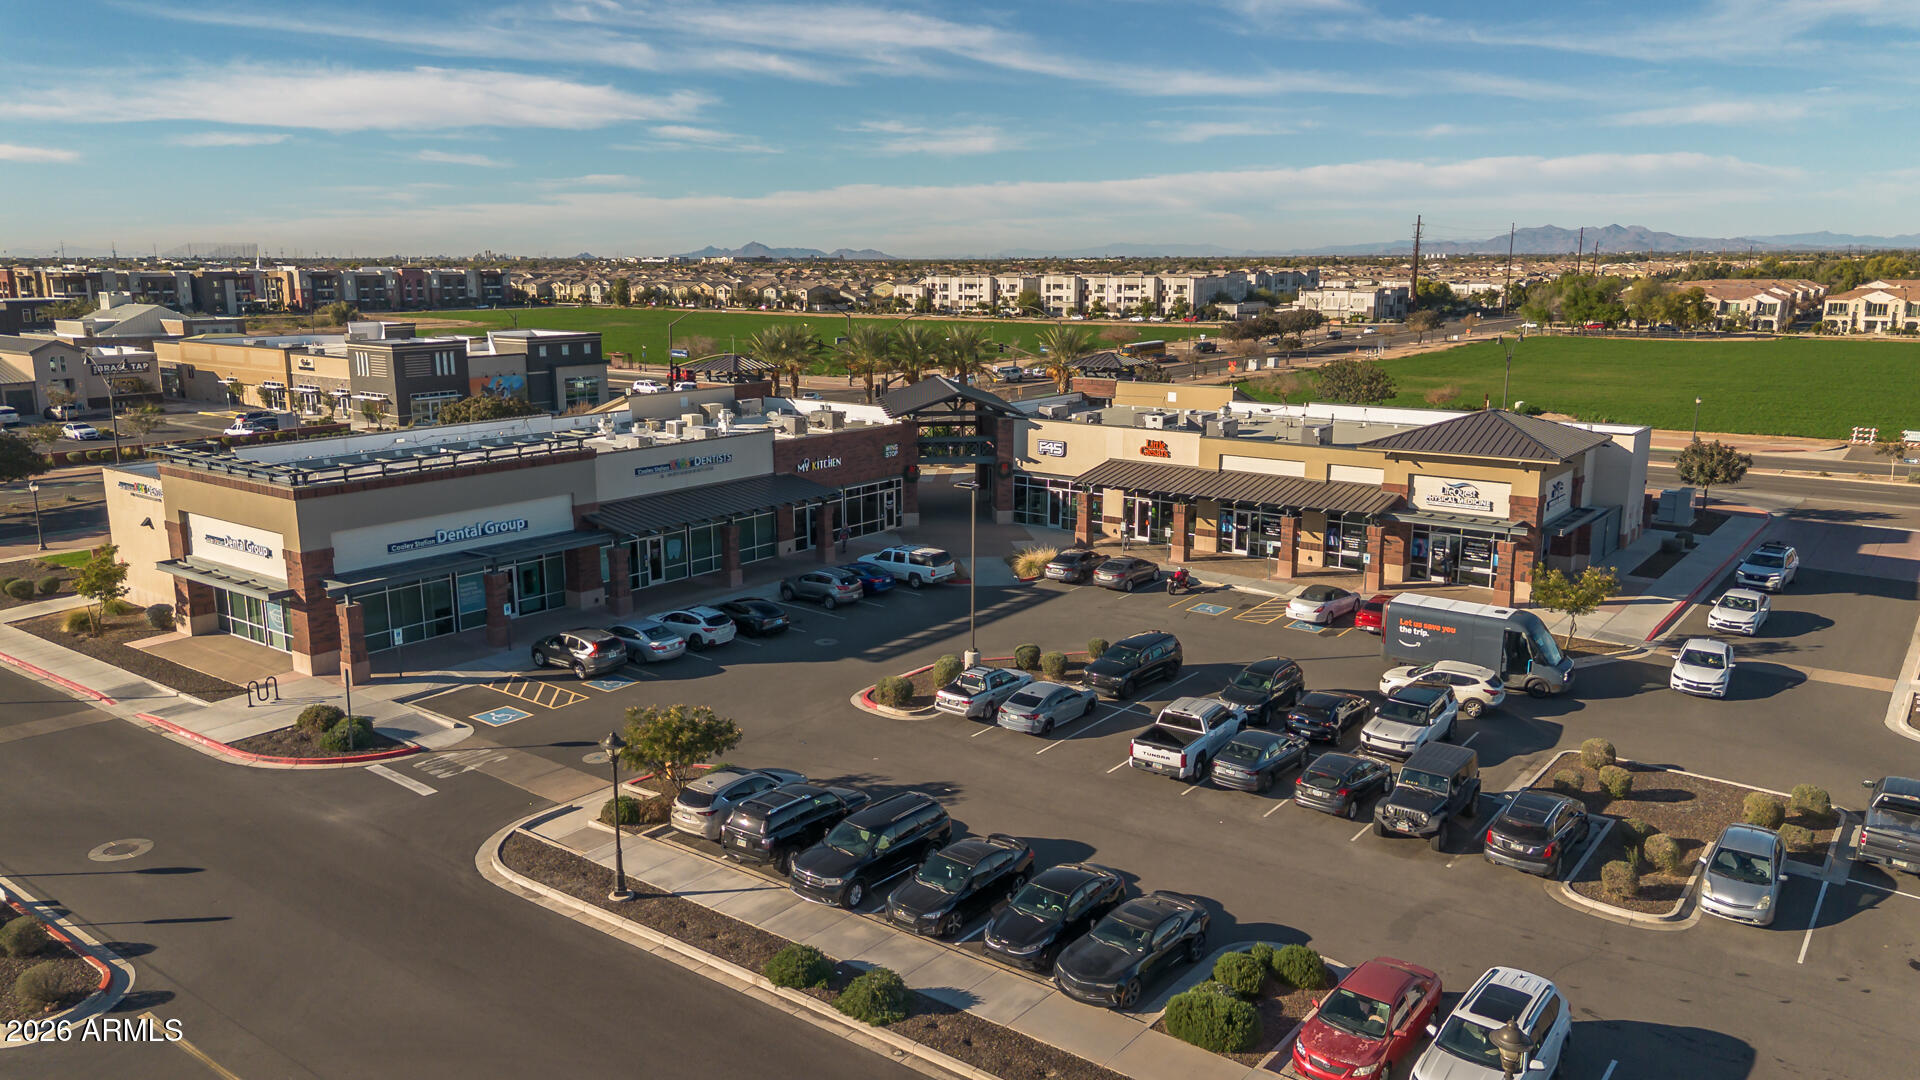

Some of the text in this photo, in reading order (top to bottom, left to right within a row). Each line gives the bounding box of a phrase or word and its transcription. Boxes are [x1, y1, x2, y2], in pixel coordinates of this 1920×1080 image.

[130, 362, 149, 370] TAP
[1039, 441, 1063, 454] F45
[1145, 439, 1167, 450] Little
[694, 454, 732, 467] DENTISTS
[811, 456, 842, 471] KITCHEN
[436, 523, 482, 544] Dental
[484, 519, 526, 535] Group
[224, 535, 247, 552] Dental
[247, 541, 269, 558] Group
[1400, 617, 1413, 627] Let
[1399, 625, 1430, 637] the trip.
[1143, 751, 1170, 760] TUNDRA
